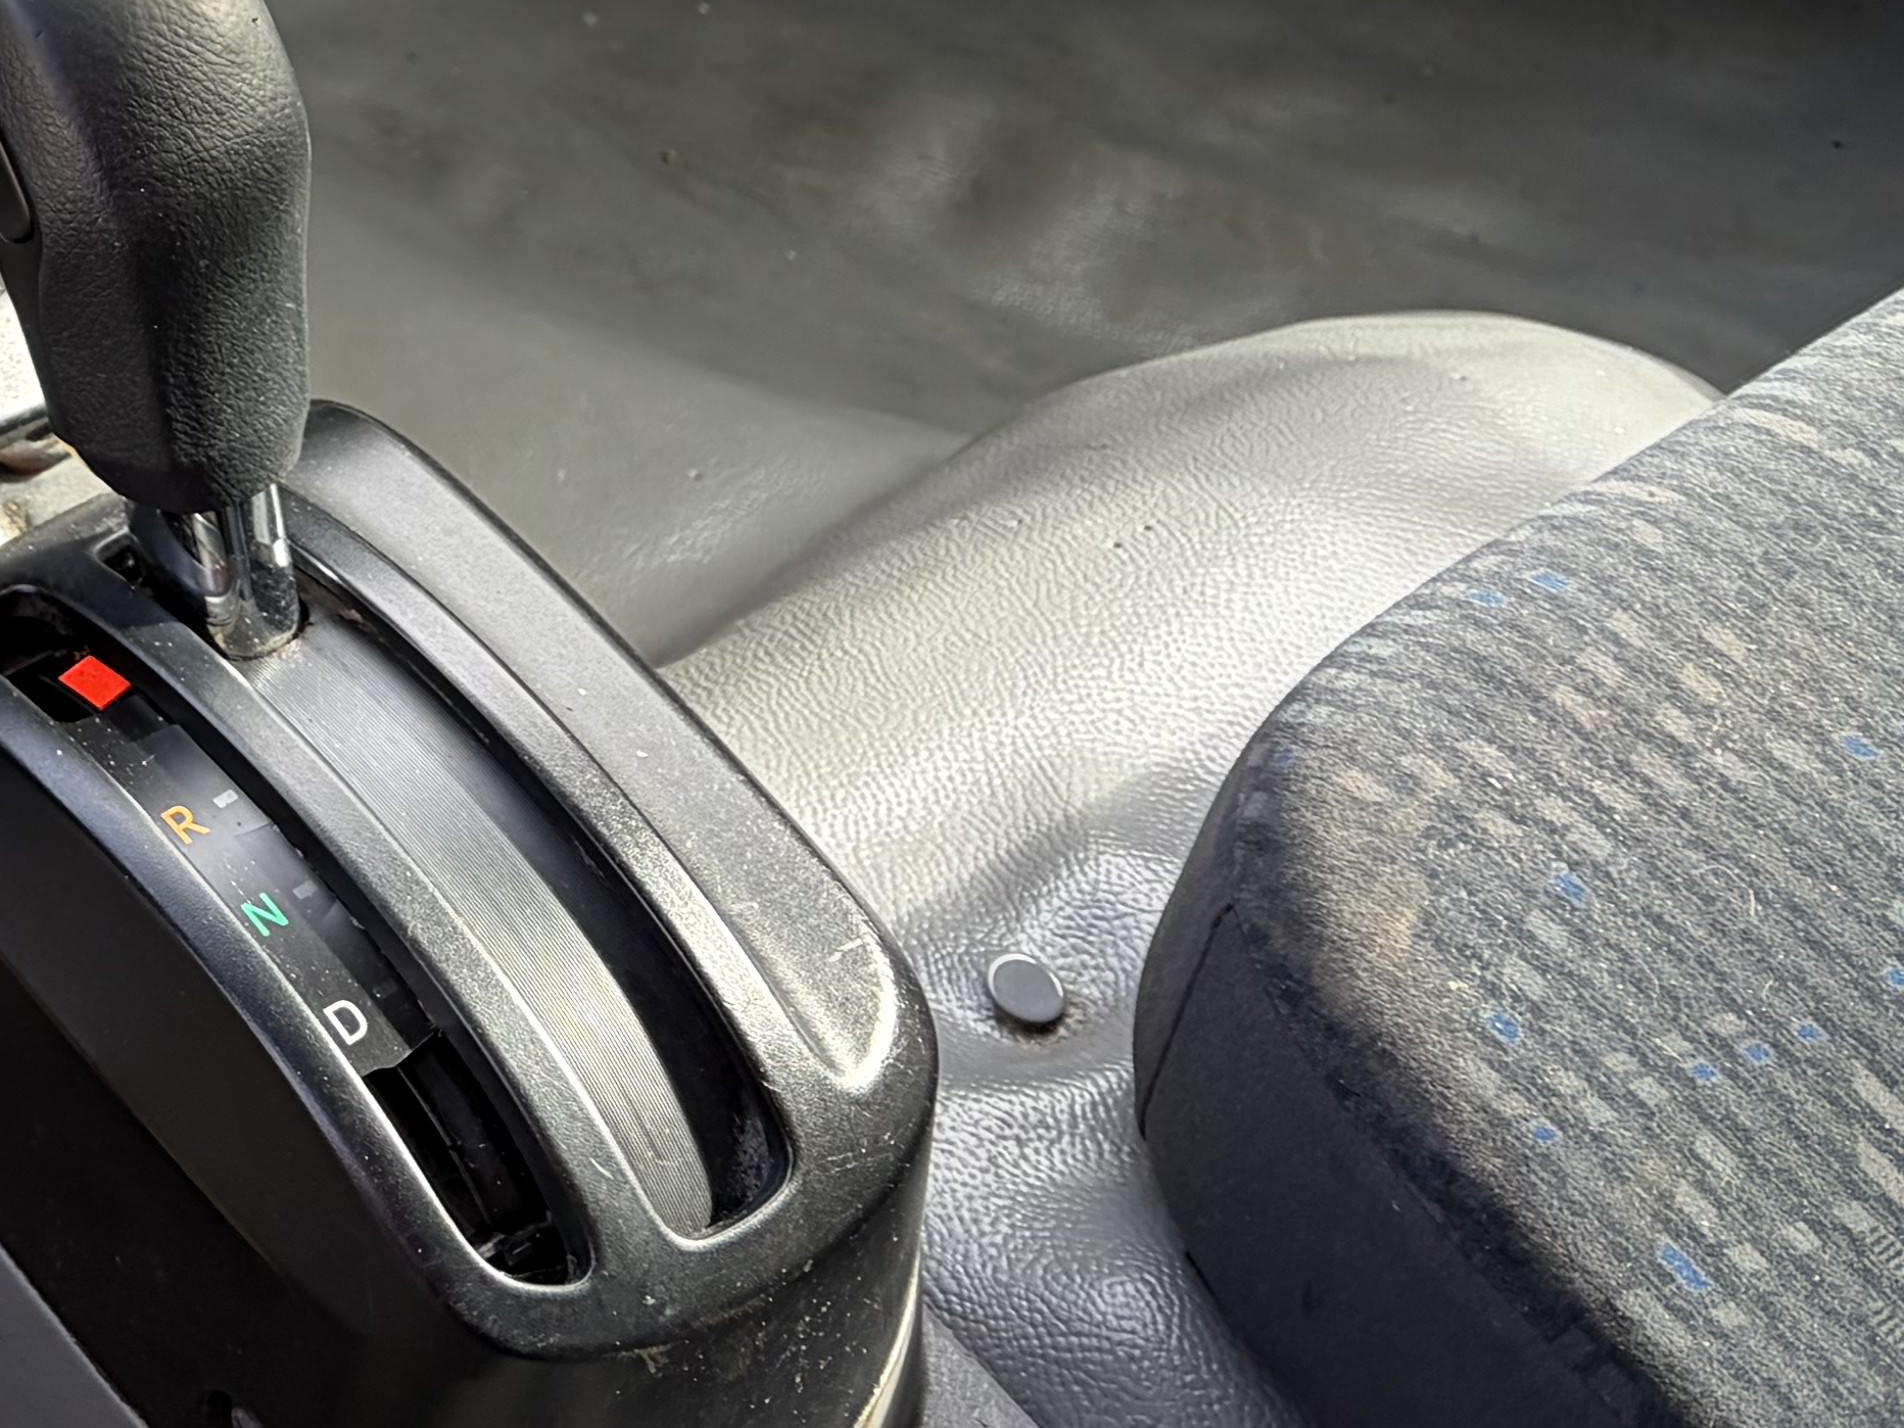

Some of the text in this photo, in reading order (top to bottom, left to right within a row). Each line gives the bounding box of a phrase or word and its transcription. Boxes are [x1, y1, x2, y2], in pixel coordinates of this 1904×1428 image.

[161, 804, 211, 844] R
[240, 892, 289, 937] N
[323, 999, 368, 1046] D
